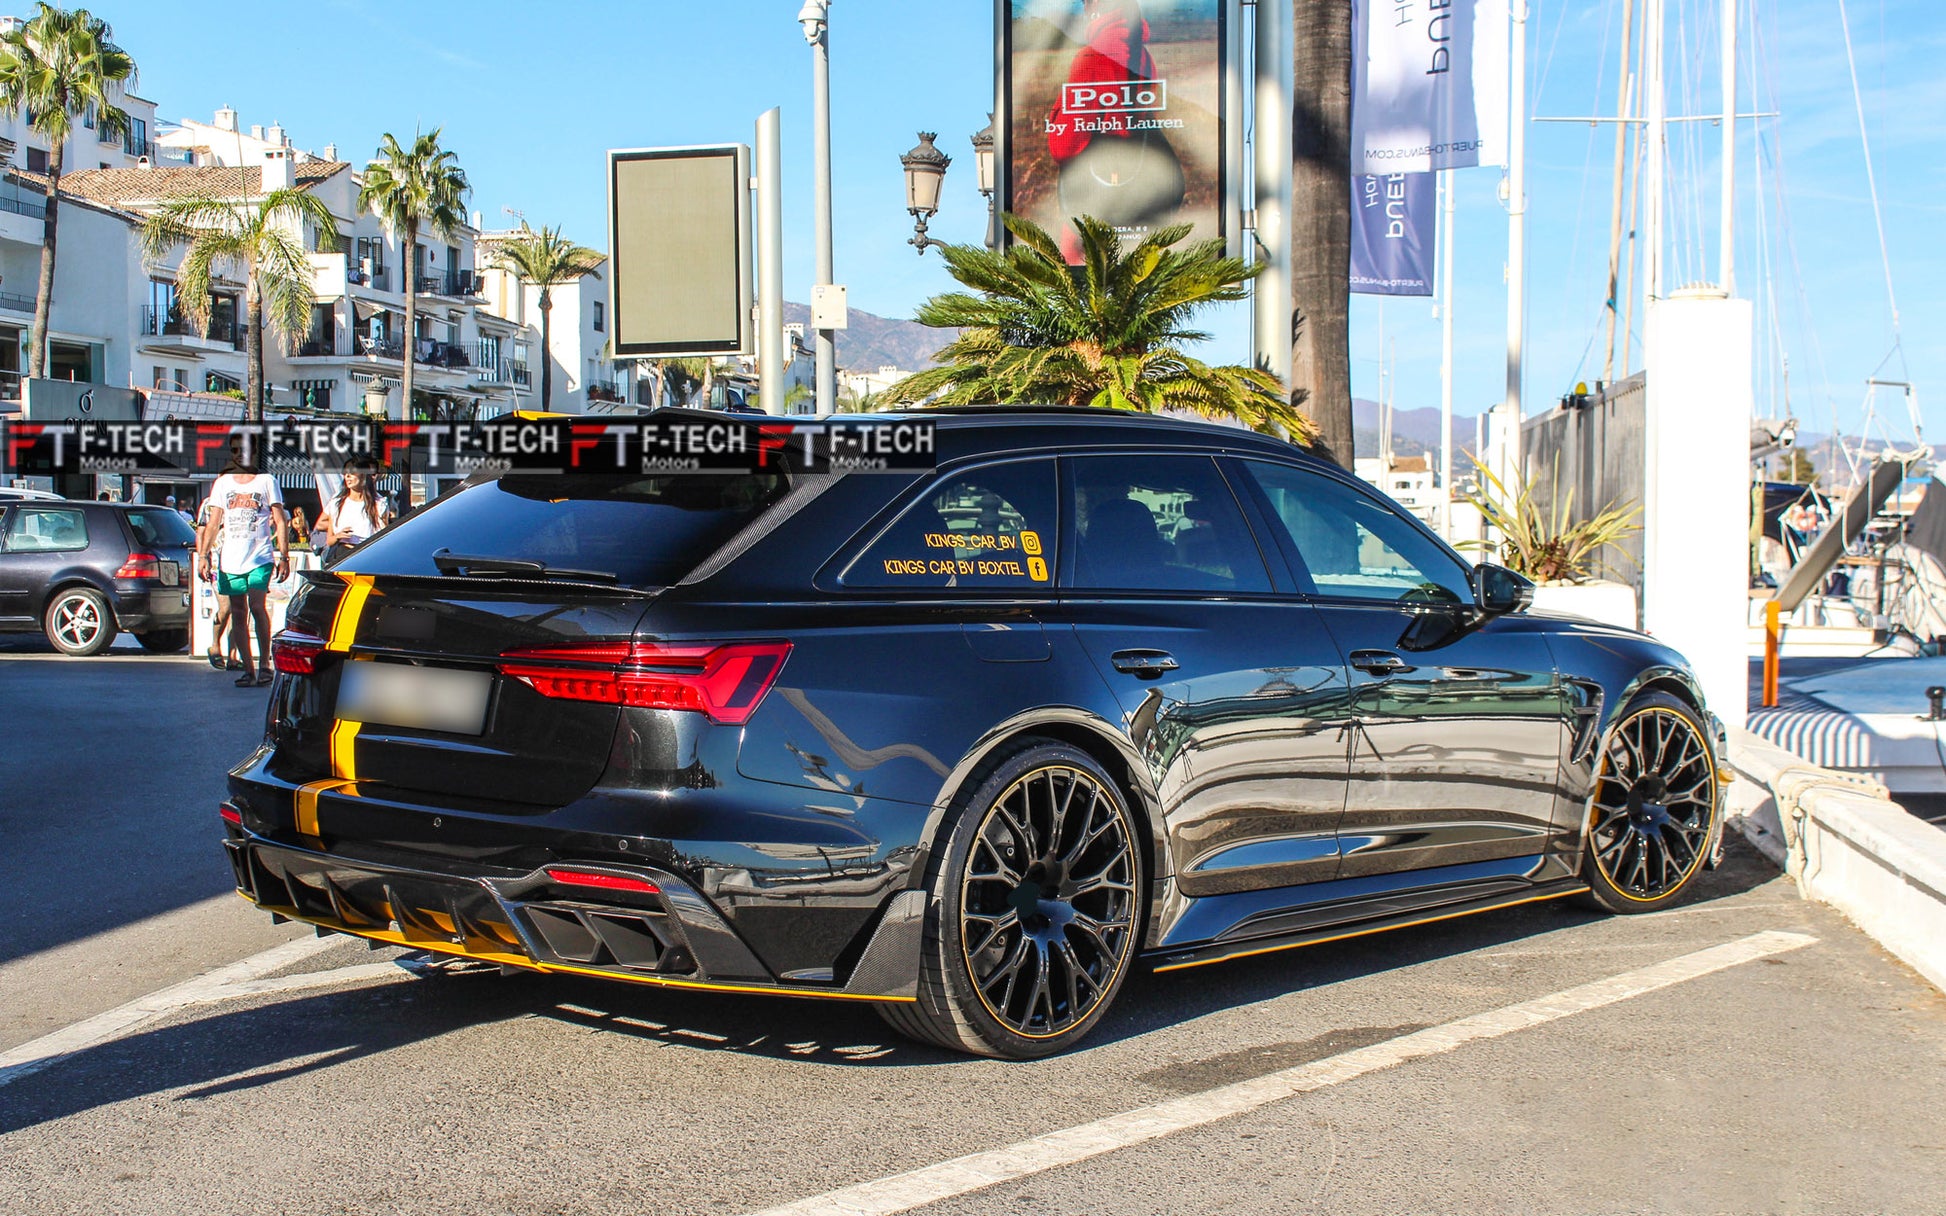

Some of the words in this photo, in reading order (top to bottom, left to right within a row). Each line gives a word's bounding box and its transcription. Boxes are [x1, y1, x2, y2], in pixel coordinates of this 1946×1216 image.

[1070, 86, 1156, 108] Polo
[1044, 119, 1067, 136] by
[1074, 116, 1122, 133] Ralph
[1125, 115, 1184, 130] Lauren
[924, 533, 1017, 551] KINGS_CAR_BV
[883, 559, 927, 575] KINGS
[929, 560, 957, 575] CAR
[958, 560, 975, 575] BV
[978, 561, 1025, 576] BOXTEL
